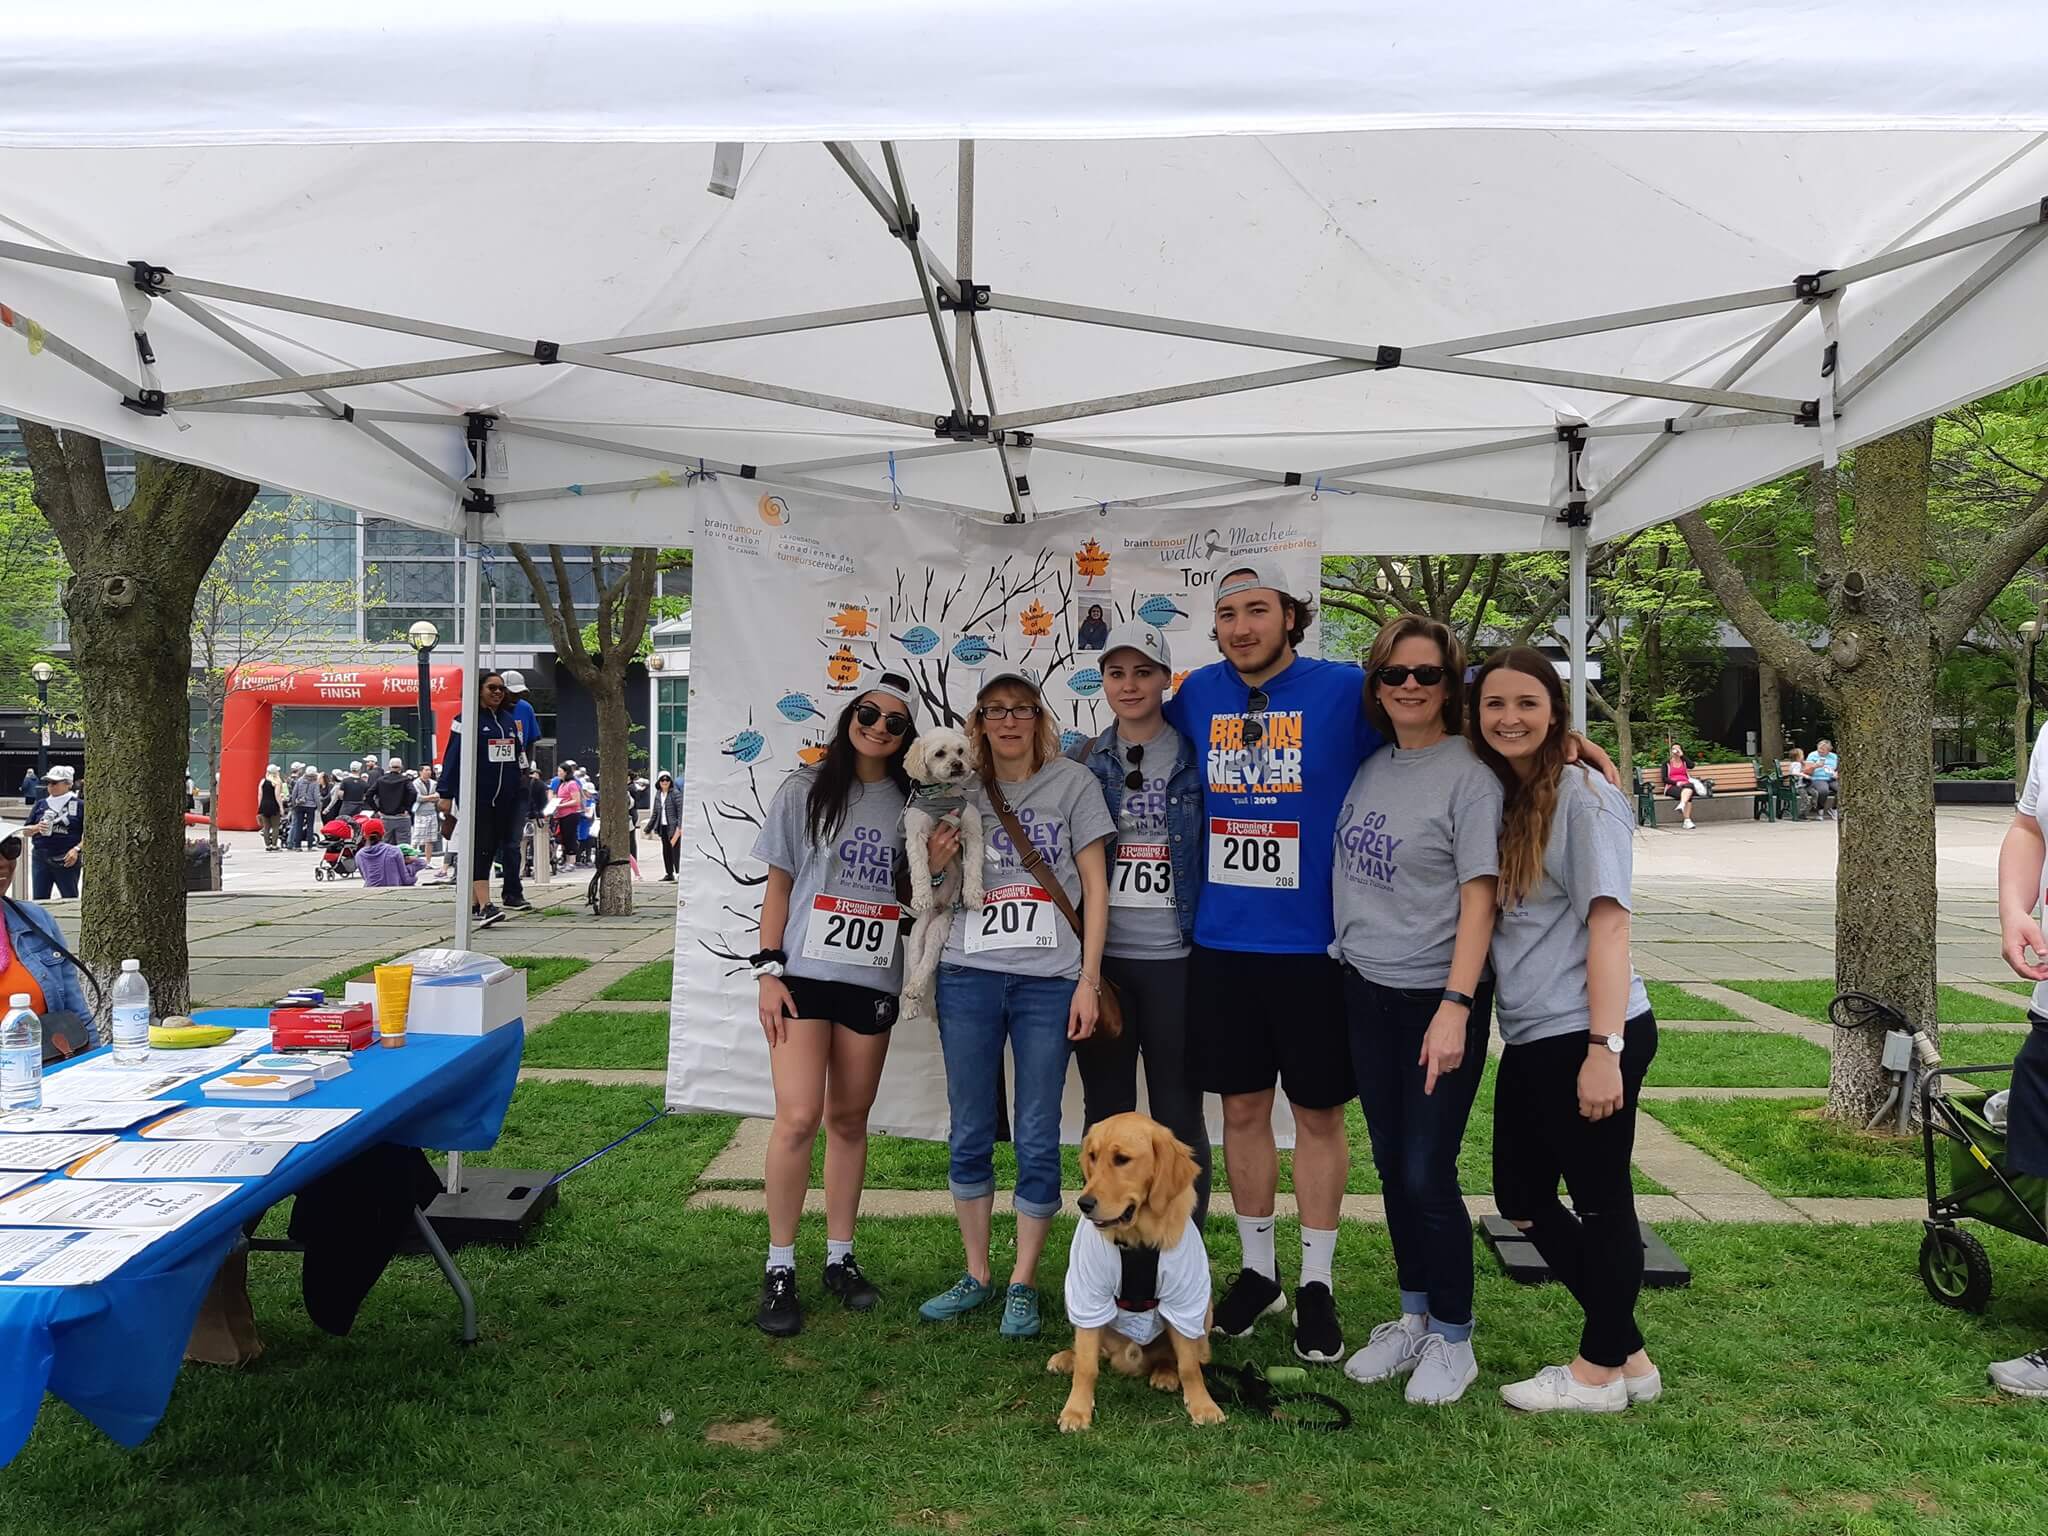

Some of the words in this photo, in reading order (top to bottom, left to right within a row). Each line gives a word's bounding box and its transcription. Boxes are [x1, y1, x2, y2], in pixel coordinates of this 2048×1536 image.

[704, 529, 760, 545] foundation
[1229, 521, 1284, 543] Marche
[788, 536, 820, 545] FONDATION
[736, 547, 758, 556] CANADA
[778, 543, 836, 559] canadienne
[840, 554, 855, 564] des
[1160, 534, 1202, 562] walk
[988, 633, 996, 642] of
[321, 672, 359, 682] START
[320, 688, 361, 698] FINISH
[1289, 710, 1303, 718] BY
[1210, 717, 1302, 742] BRIN
[1210, 736, 1303, 750] TUMURS
[495, 745, 512, 757] 759
[1207, 748, 1303, 768] SHOULD
[1208, 764, 1302, 784] NEVER
[1140, 778, 1166, 792] GO
[1209, 783, 1247, 793] WALK
[1252, 783, 1302, 793] ALONE
[1127, 793, 1166, 819] GR
[1253, 796, 1277, 804] 2019
[1014, 808, 1035, 823] O
[1363, 811, 1386, 830] GO
[1136, 820, 1148, 829] IN
[1232, 822, 1267, 834] Running
[854, 826, 882, 843] GO
[1344, 825, 1403, 862] GREY
[1001, 856, 1014, 867] IN
[1038, 848, 1063, 864] AY
[1126, 845, 1160, 857] Running
[1223, 837, 1280, 873] 208
[841, 869, 855, 879] IN
[1356, 855, 1398, 883] MAY
[1116, 861, 1171, 893] 763
[1275, 877, 1293, 887] 208
[992, 885, 1025, 901] Running
[841, 900, 877, 913] Running
[1164, 897, 1176, 906] 76
[982, 901, 1039, 936] 207
[824, 914, 884, 953] 209
[1036, 936, 1053, 946] 207
[873, 956, 888, 966] 209
[144, 1197, 173, 1208] 27
